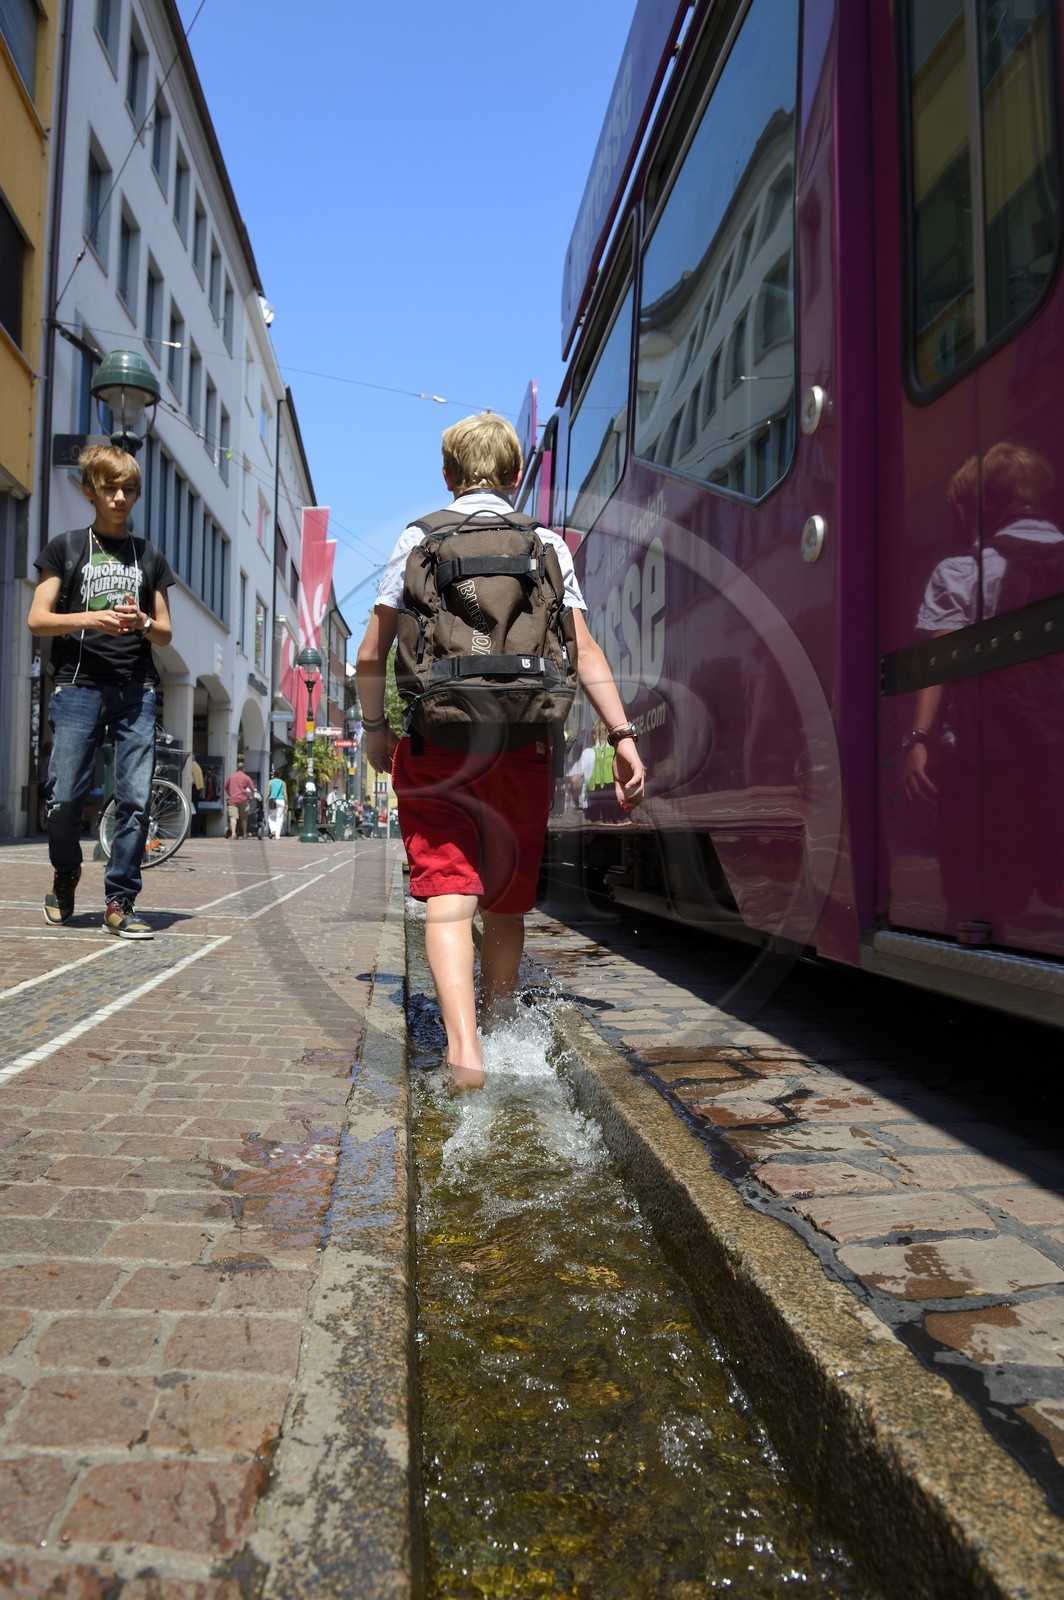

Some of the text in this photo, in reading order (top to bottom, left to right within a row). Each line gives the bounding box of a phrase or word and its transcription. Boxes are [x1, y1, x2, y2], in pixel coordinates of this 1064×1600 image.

[604, 488, 668, 587] Alles finden.
[81, 562, 143, 584] DROPKICK
[80, 576, 142, 604] MURPHYS
